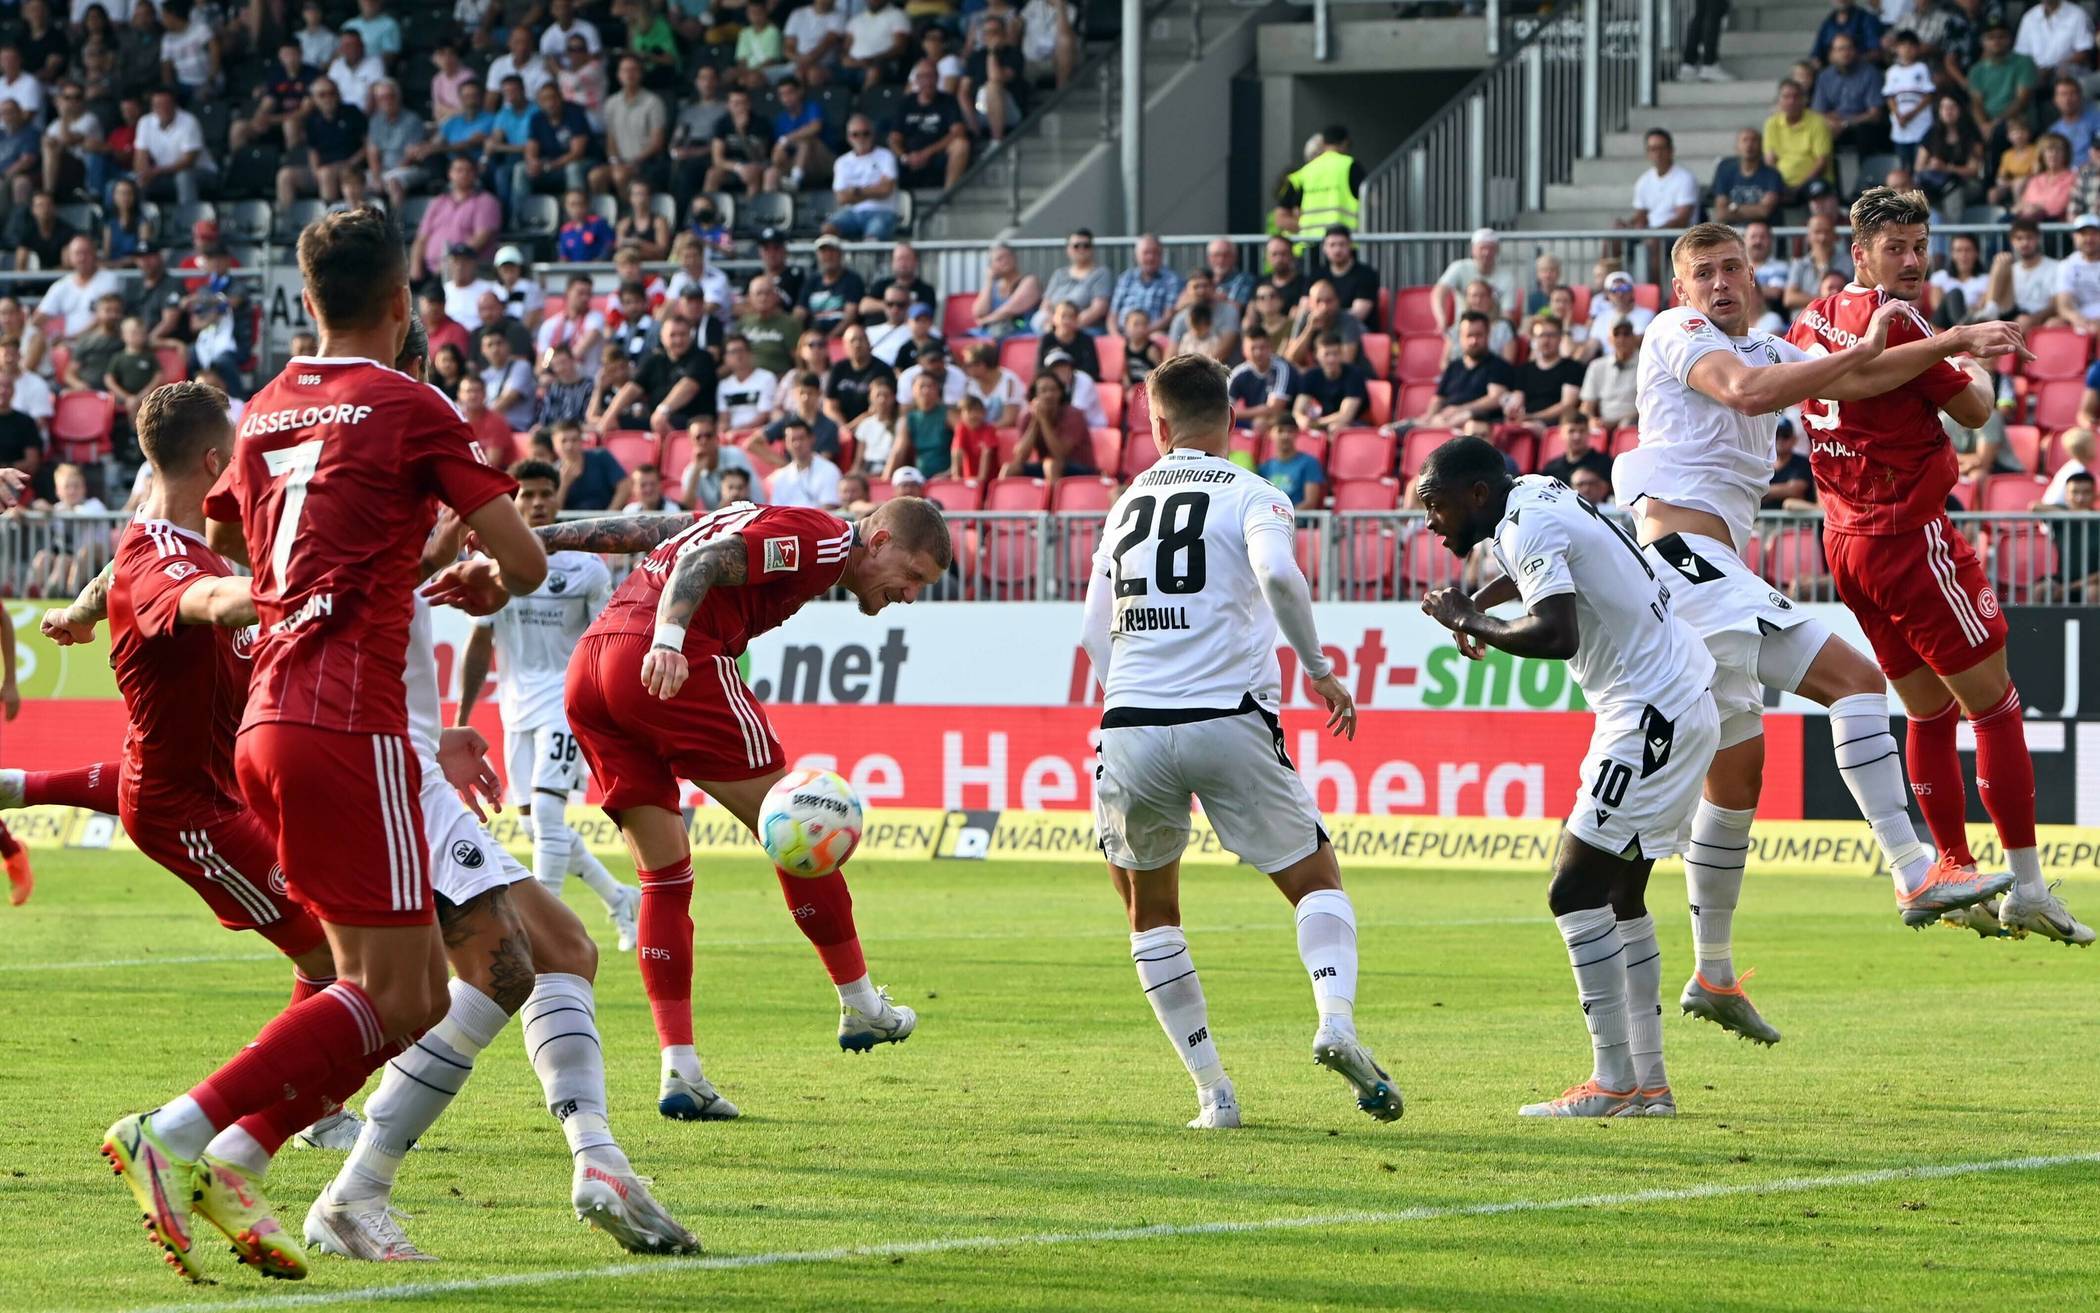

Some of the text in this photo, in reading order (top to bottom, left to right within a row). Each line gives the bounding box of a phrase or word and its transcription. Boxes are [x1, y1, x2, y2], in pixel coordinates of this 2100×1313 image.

[297, 374, 321, 385] 1895
[240, 403, 373, 438] ÜSSELDORF
[1139, 468, 1236, 487] SANDHAUSEN
[262, 440, 324, 598] 7
[1113, 491, 1210, 600] 28
[1591, 758, 1632, 808] 10
[1749, 837, 1875, 864] PUMPEN
[641, 946, 671, 961] F95
[1313, 966, 1337, 981] SVS
[1187, 1026, 1208, 1048] SVS
